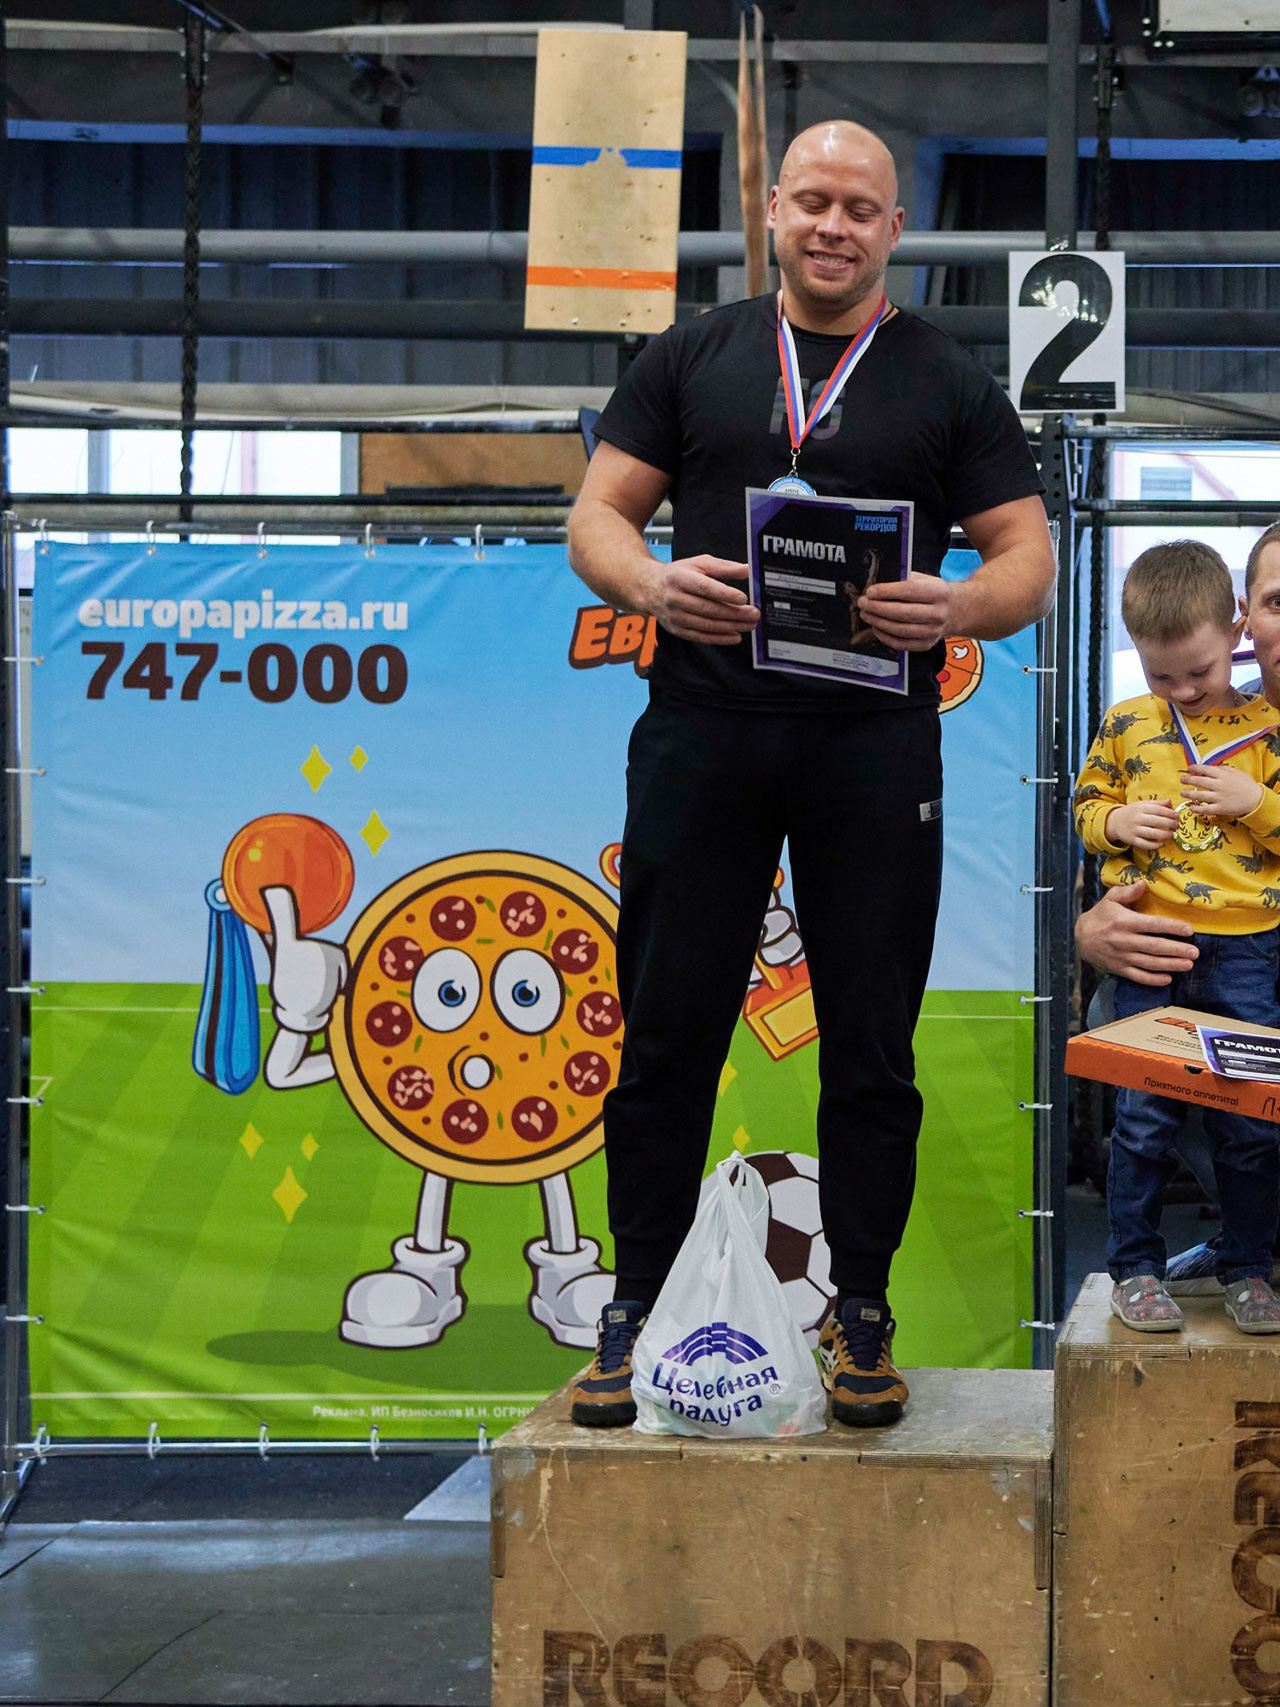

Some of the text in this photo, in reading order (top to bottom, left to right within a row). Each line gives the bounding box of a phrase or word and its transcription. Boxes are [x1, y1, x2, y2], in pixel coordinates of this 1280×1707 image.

[1018, 254, 1116, 410] 2
[854, 522, 898, 533] РЕКОРДОВ
[763, 534, 847, 563] ГРАМОТА
[79, 589, 408, 639] europapizza.ru
[81, 641, 408, 705] 747-000
[1143, 1076, 1240, 1107] Приятного аппетита!
[652, 1361, 778, 1401] Целебная
[371, 1405, 389, 1418] ИП
[392, 1406, 462, 1418] Безносиков
[542, 1628, 994, 1707] RECORD
